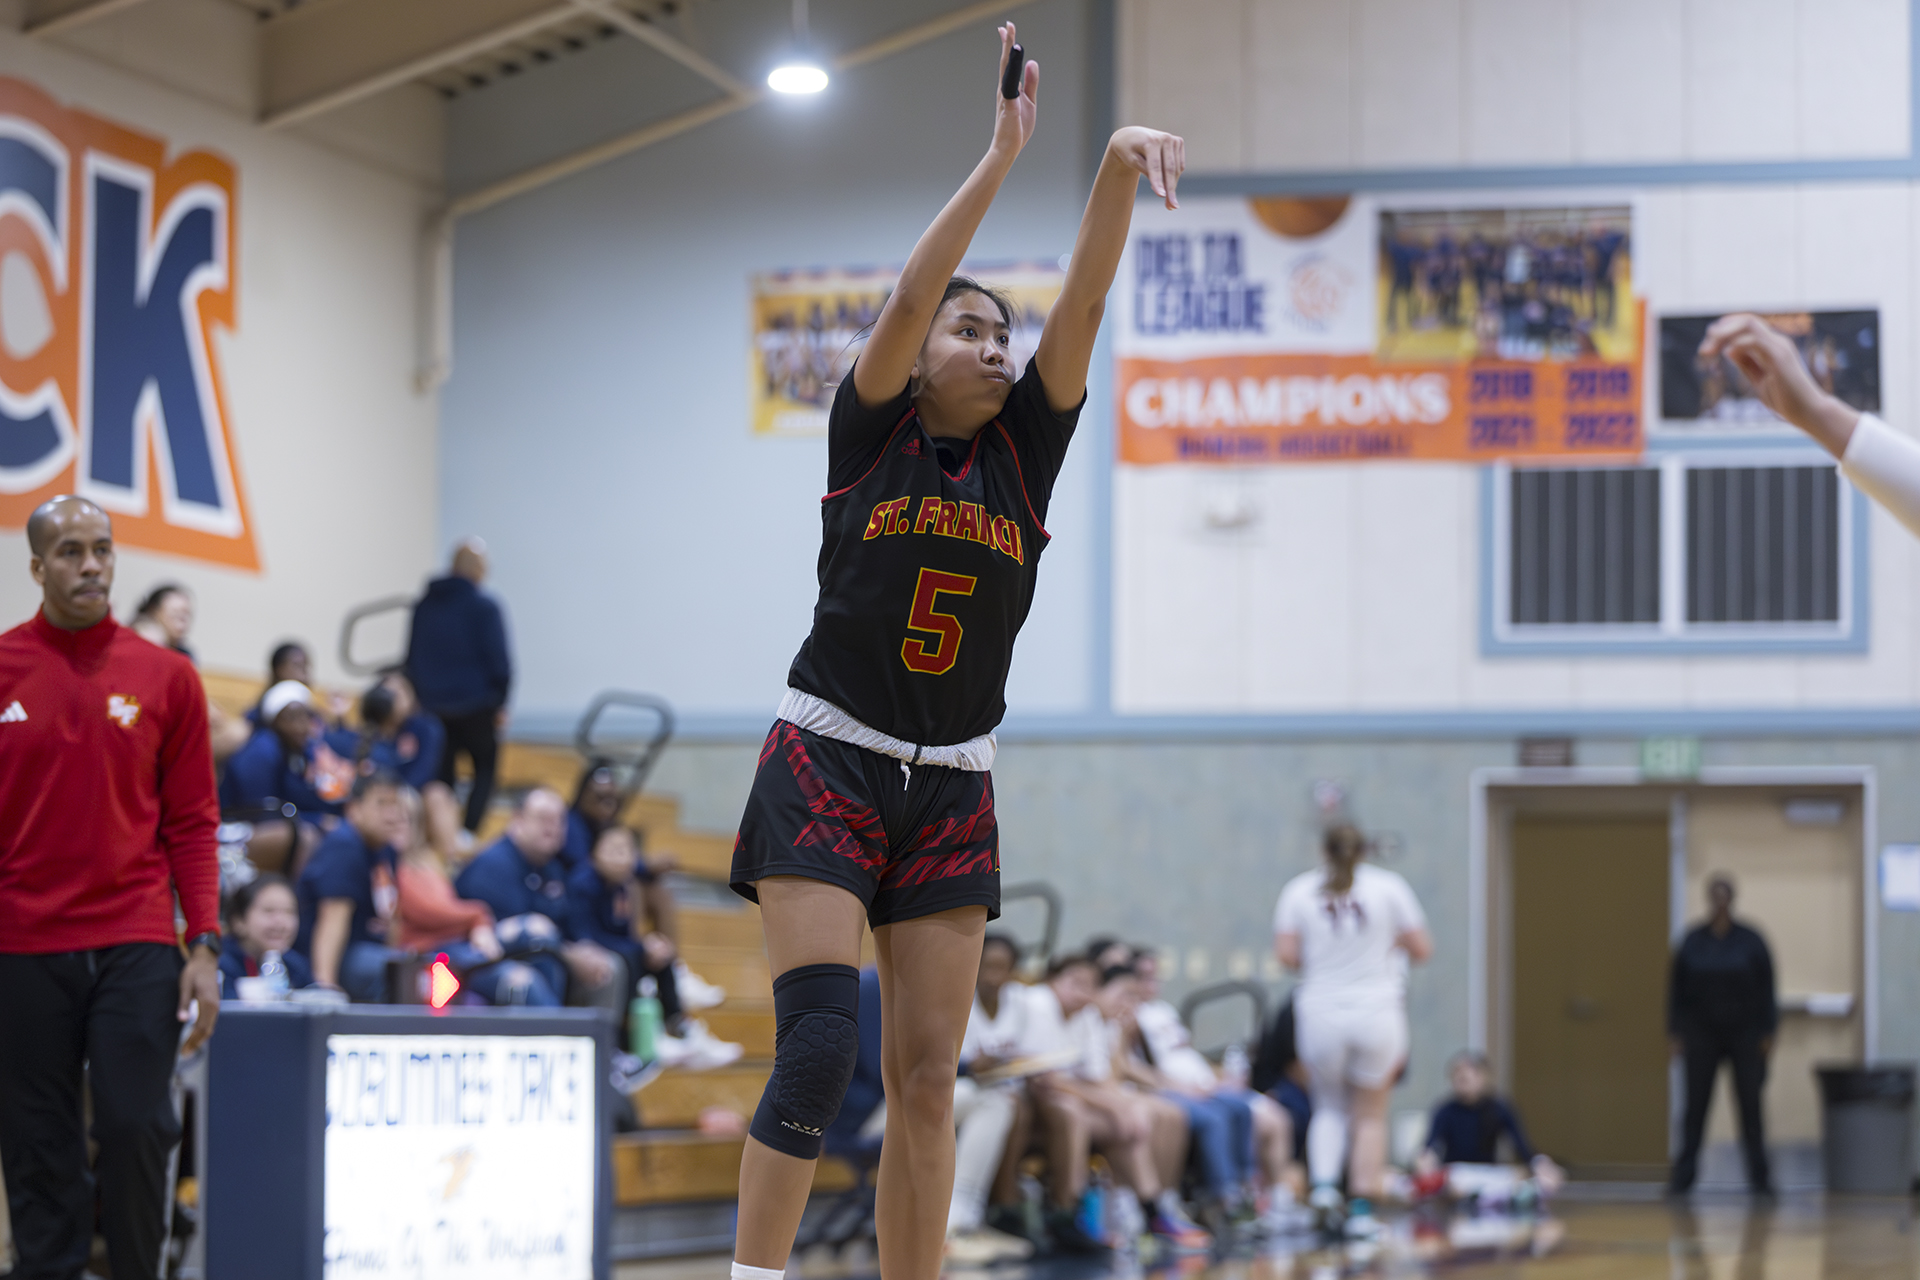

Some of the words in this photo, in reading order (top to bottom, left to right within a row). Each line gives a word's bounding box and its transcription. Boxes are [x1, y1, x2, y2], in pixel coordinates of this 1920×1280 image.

[1135, 234, 1243, 281] DELTA
[1135, 281, 1267, 335] LEAGUE
[1125, 371, 1451, 429] CHAMPIONS
[863, 496, 910, 541] ST.
[901, 567, 977, 675] 5
